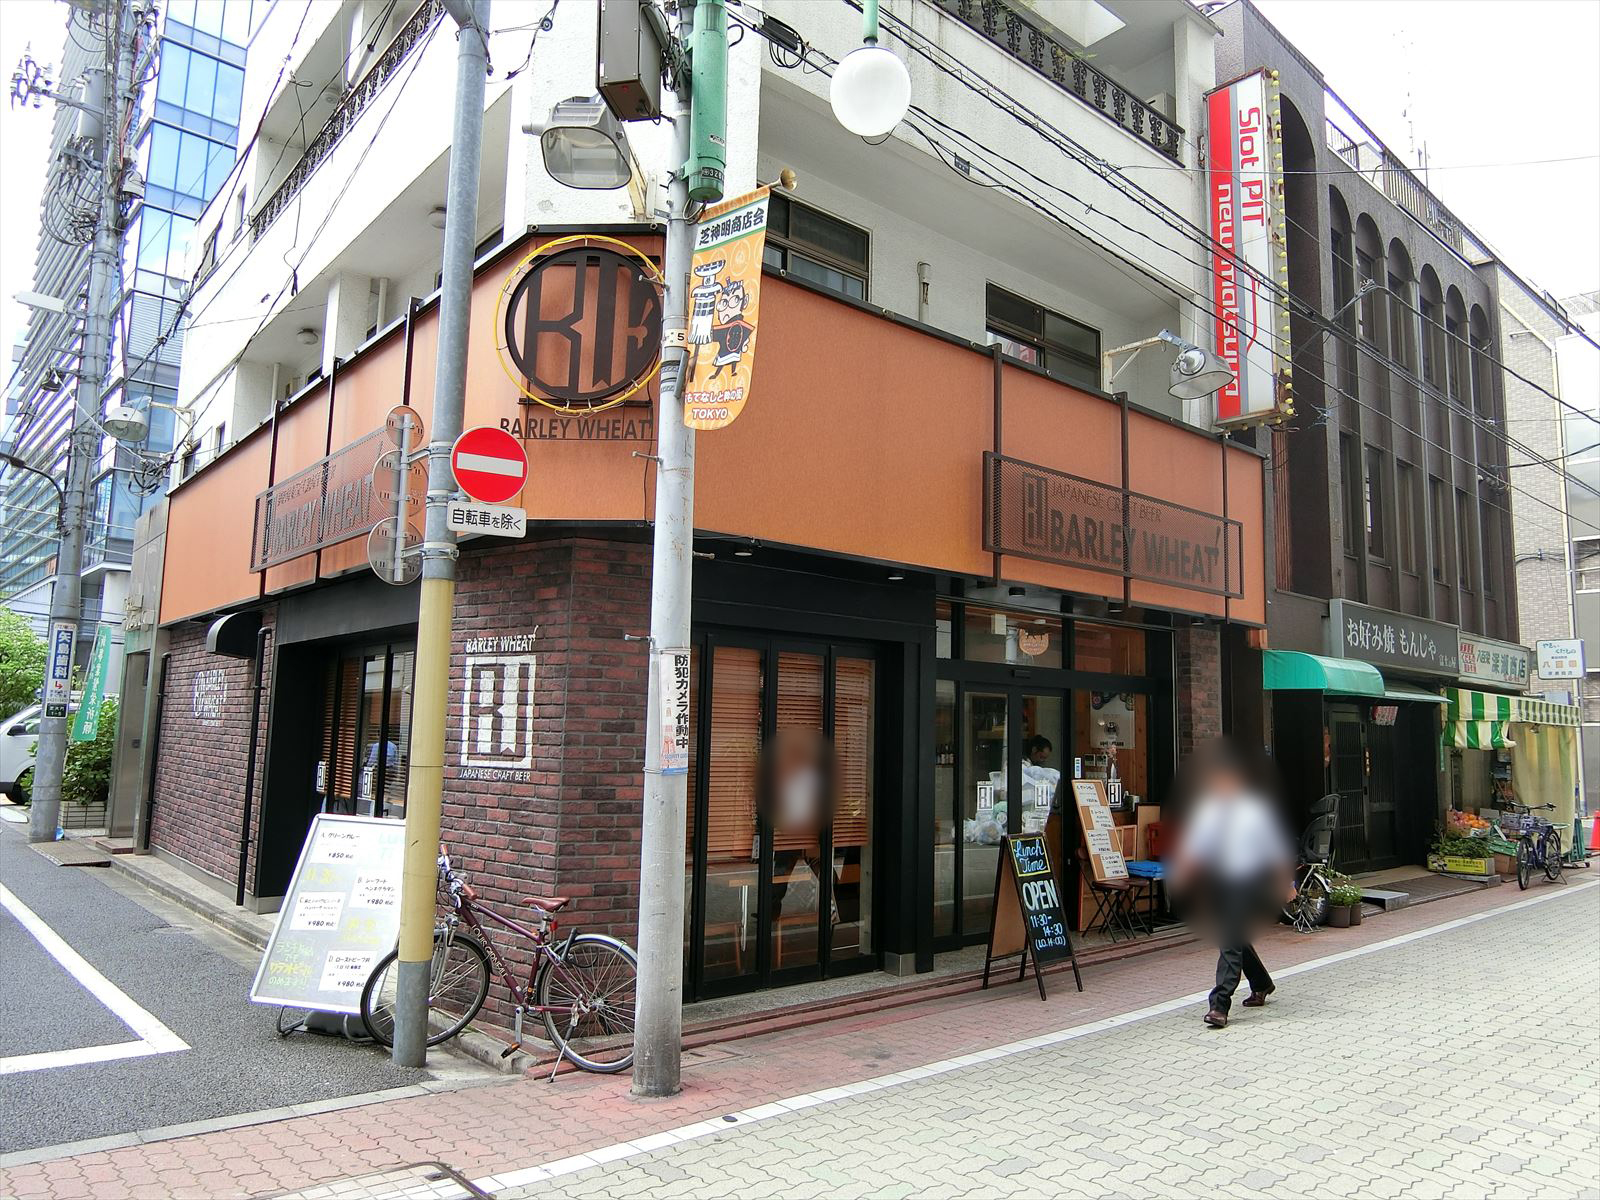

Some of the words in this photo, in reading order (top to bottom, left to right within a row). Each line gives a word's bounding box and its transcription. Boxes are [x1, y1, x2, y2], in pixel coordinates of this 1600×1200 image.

[1239, 106, 1260, 170] Slot
[1217, 183, 1233, 254] new
[1242, 179, 1264, 227] PIT
[698, 207, 765, 245] 芝神明商店会
[499, 417, 572, 439] BARLEY
[692, 408, 729, 420] TOKYO
[452, 508, 522, 530] 自転車を除く
[1051, 481, 1104, 508] JAPANESE
[1140, 503, 1162, 523] BEER
[1051, 508, 1137, 566] BARLEY
[54, 631, 73, 678] 矢島歯科
[465, 636, 499, 653] BARLEY
[500, 633, 534, 652] WHEAT
[1346, 618, 1395, 654] お好み焼
[1399, 628, 1437, 660] もんじゃ
[674, 654, 689, 749] 防犯カメラ作動中
[459, 768, 492, 780] JAPANESE
[492, 769, 515, 781] CRAFT
[515, 771, 531, 782] BEER
[1014, 839, 1045, 858] Lunch
[1019, 857, 1047, 873] Time
[1022, 878, 1060, 911] OPEN
[1043, 922, 1063, 937] 14:30
